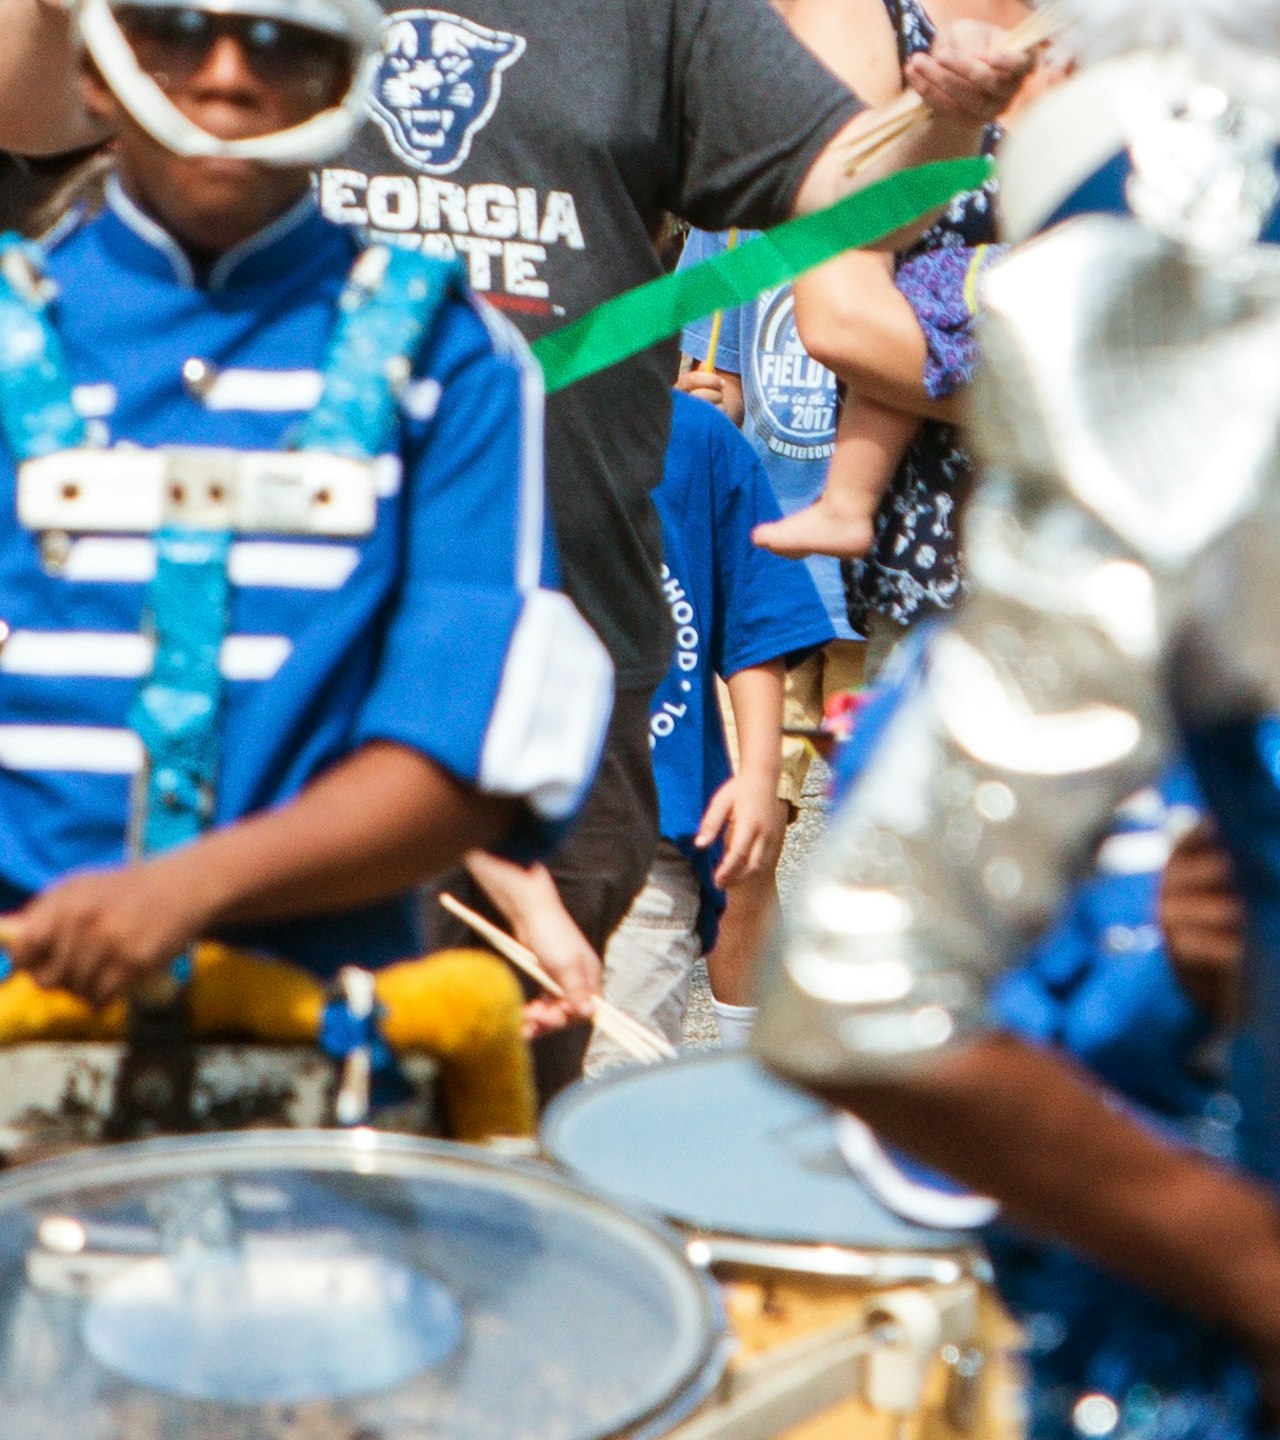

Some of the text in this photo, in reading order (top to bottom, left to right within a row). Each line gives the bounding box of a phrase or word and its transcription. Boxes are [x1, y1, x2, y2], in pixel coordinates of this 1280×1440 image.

[310, 167, 586, 251] EORGIA
[762, 354, 823, 389] FIELD
[791, 405, 833, 431] 2017
[661, 562, 699, 672] HOOD
